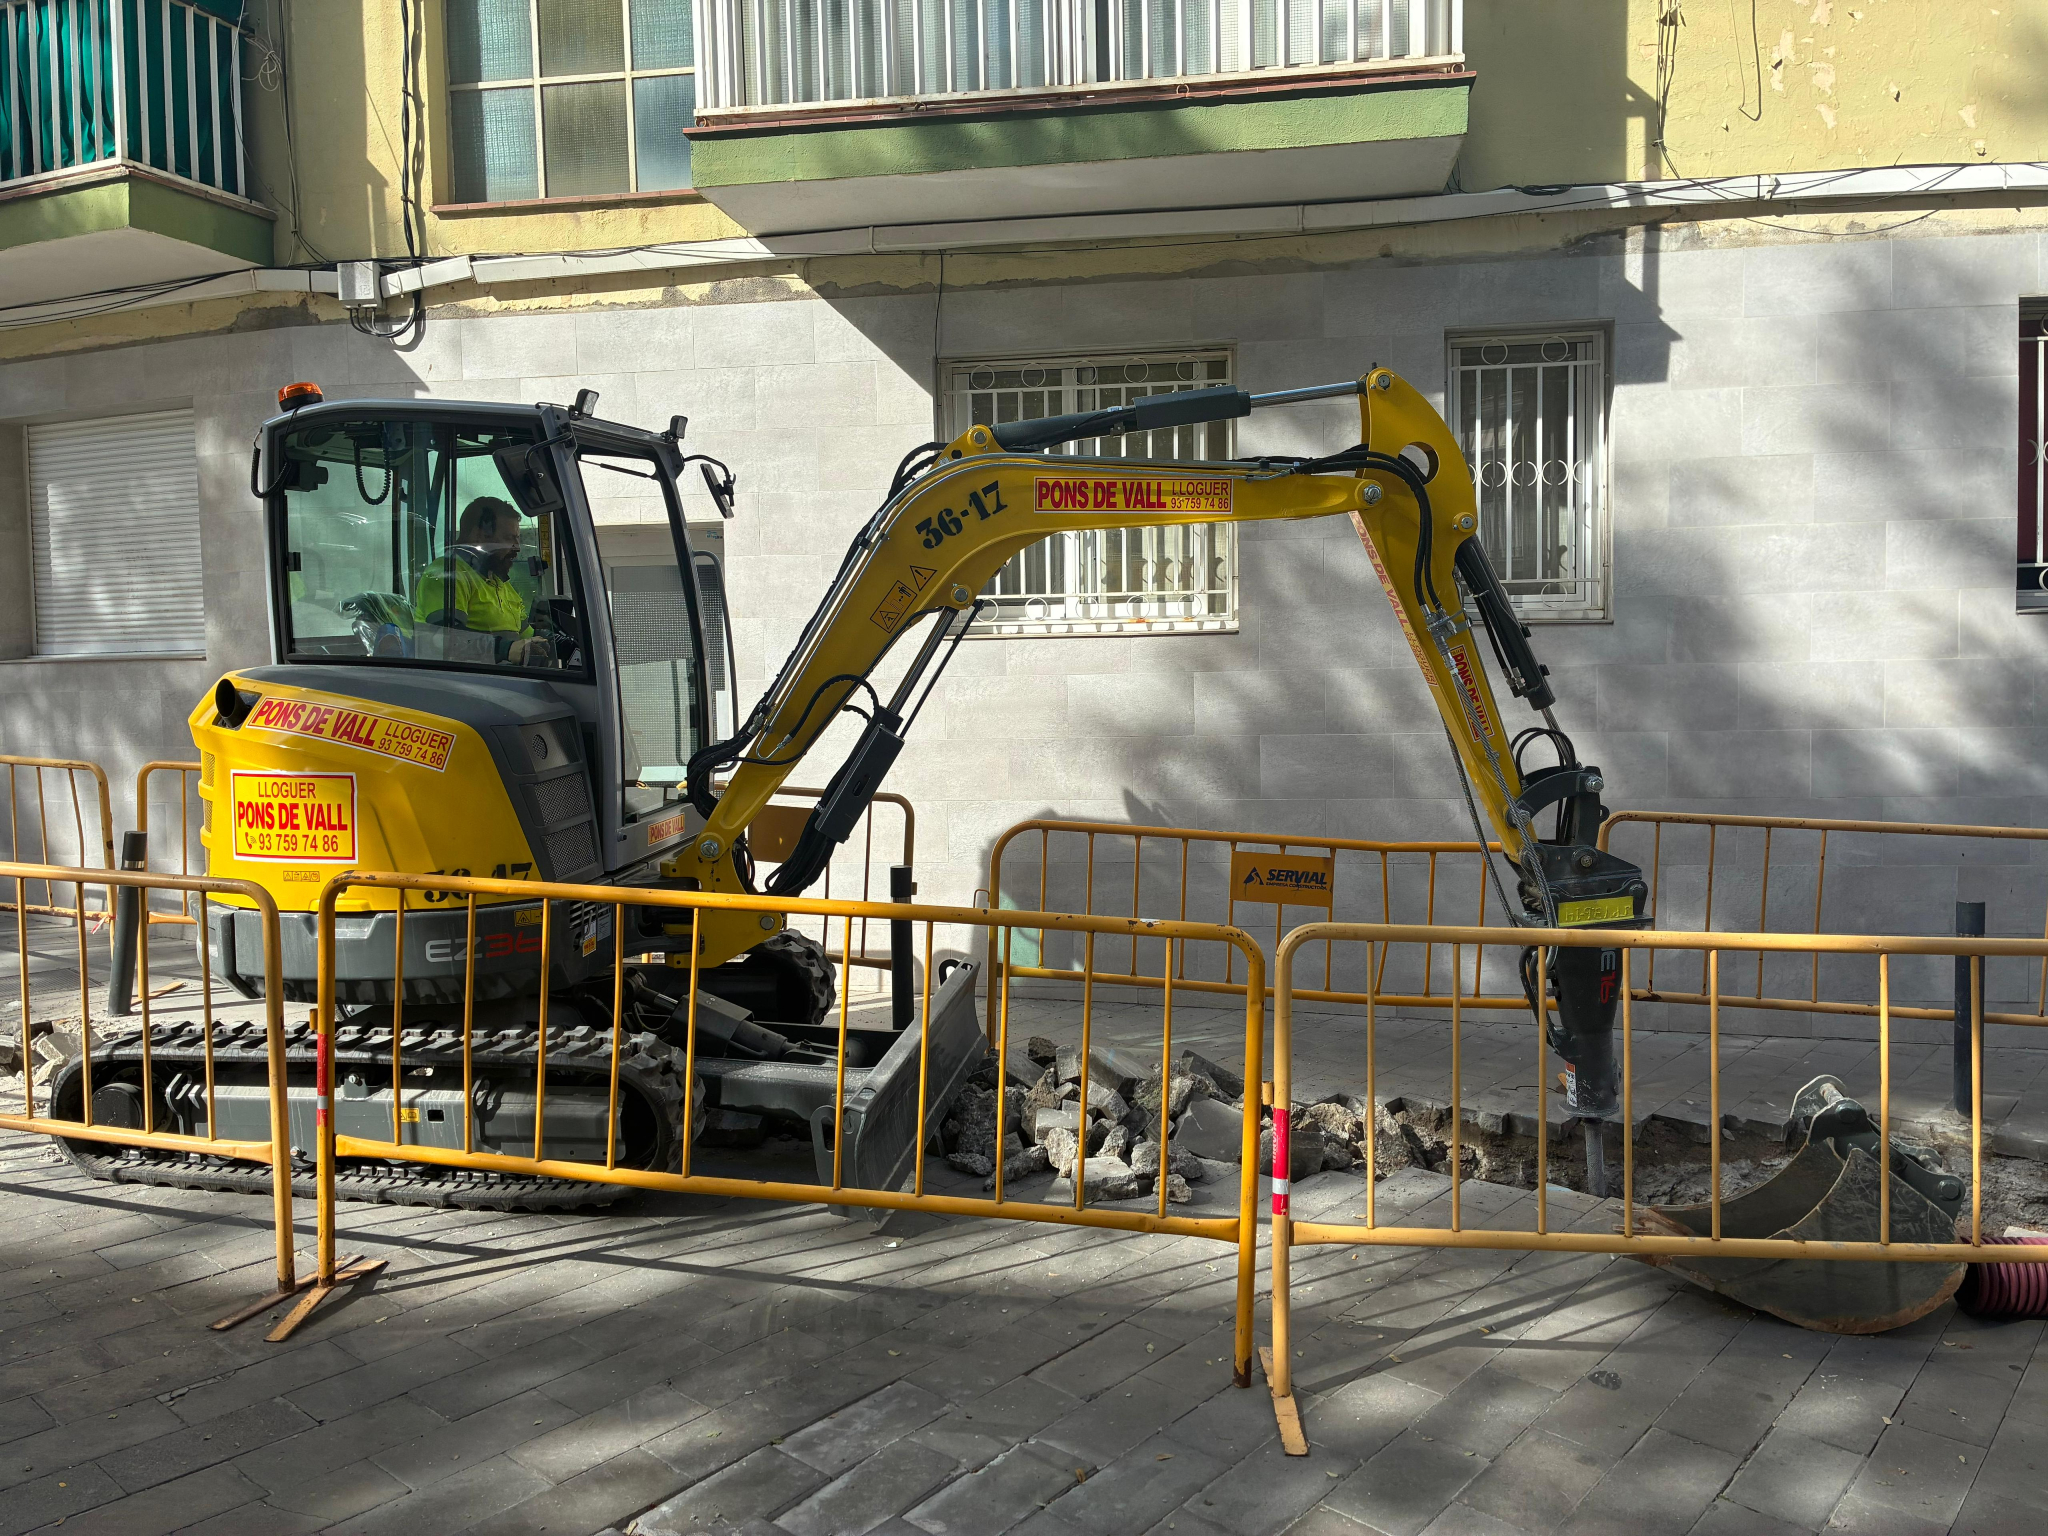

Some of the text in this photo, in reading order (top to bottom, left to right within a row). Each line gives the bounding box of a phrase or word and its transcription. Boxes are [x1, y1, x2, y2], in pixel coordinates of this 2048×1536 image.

[1038, 480, 1166, 509] PONS DE VALL
[1172, 481, 1229, 496] LLOGUER
[915, 480, 1007, 549] 36-17
[1171, 498, 1229, 509] 93 759 74 86
[1373, 563, 1391, 585] DE
[1386, 587, 1409, 628] VALL
[252, 700, 379, 747] PONS DE VALL
[384, 722, 449, 752] LLOGUER
[378, 737, 444, 766] 93 759 74 86
[258, 781, 317, 799] LLOGUER
[237, 801, 348, 831] PONS DE VALL
[258, 832, 339, 852] 93 759 74 86
[650, 821, 665, 843] PONS
[1266, 868, 1327, 885] SERVIAL
[425, 931, 545, 963] EZ36
[1600, 947, 1617, 1004] E16
